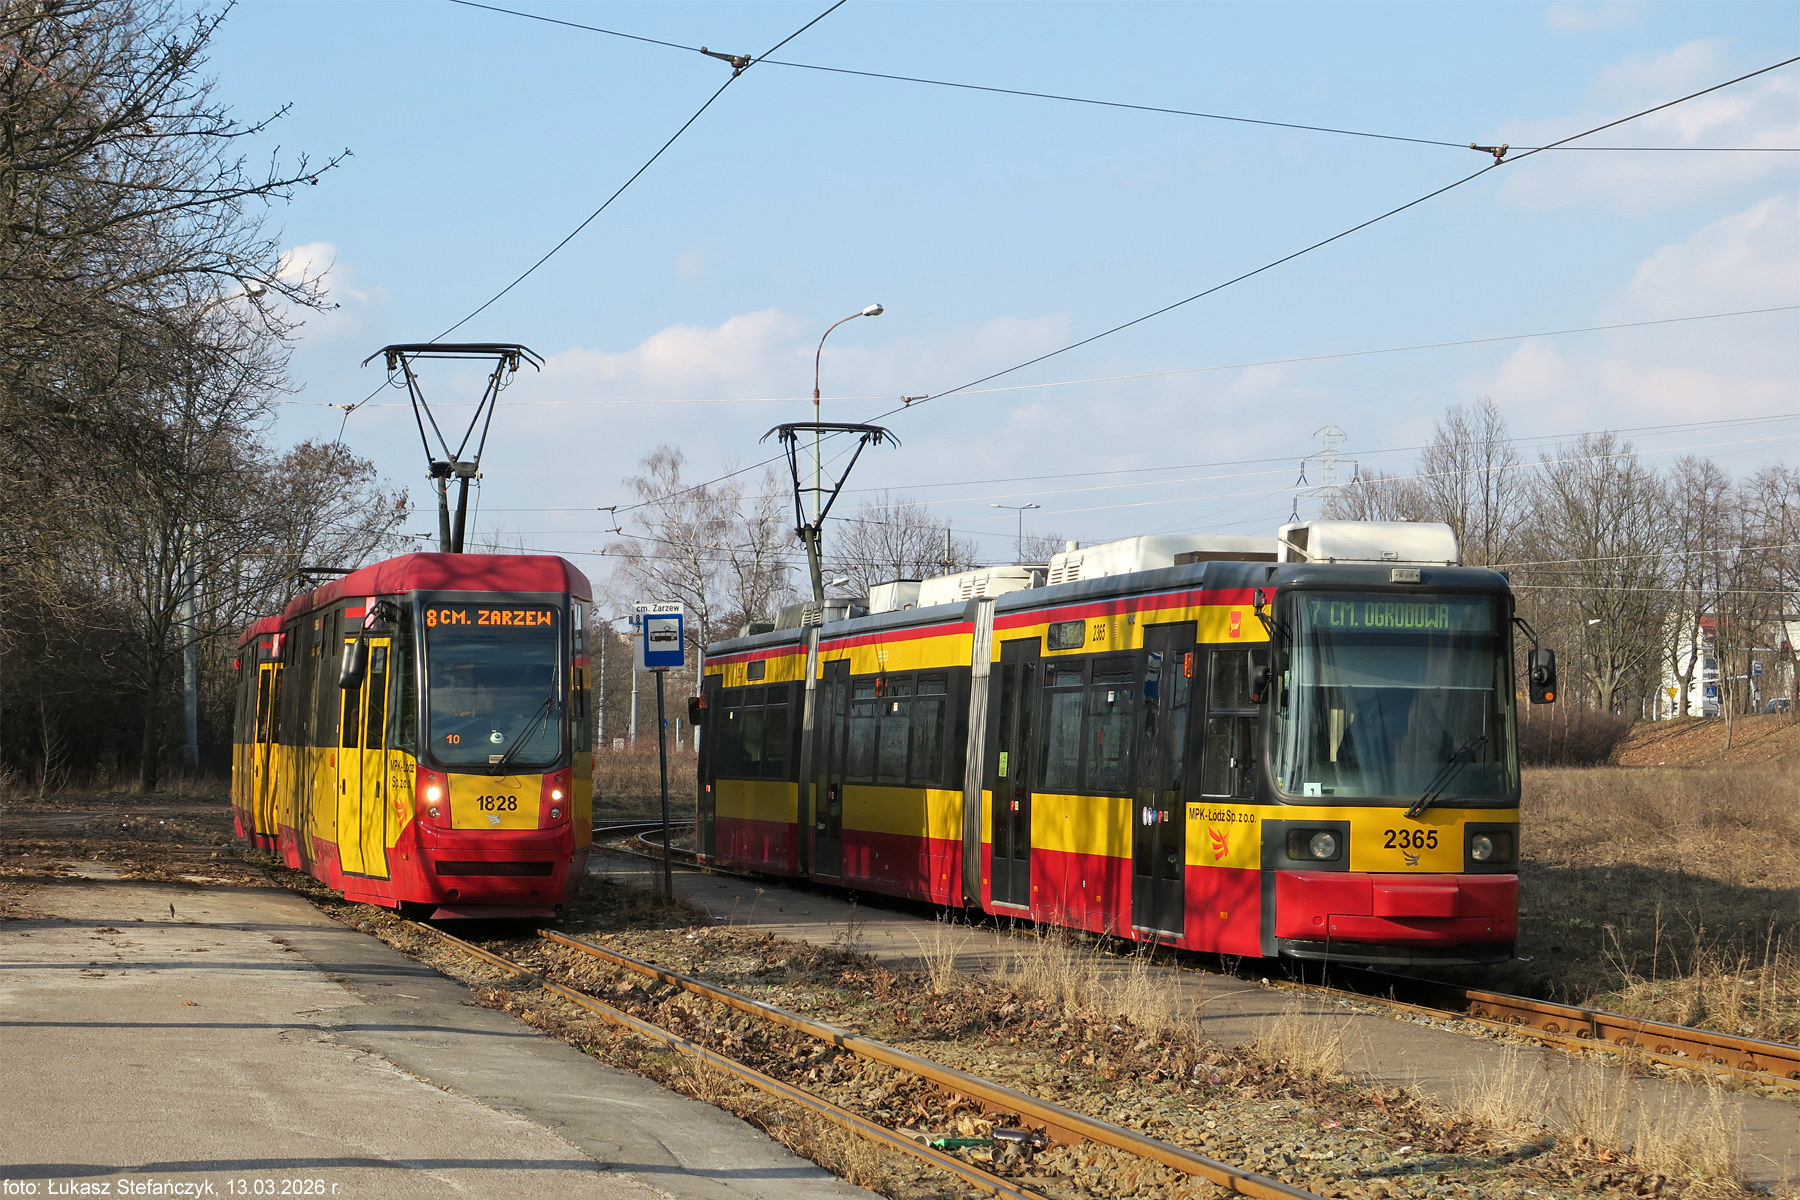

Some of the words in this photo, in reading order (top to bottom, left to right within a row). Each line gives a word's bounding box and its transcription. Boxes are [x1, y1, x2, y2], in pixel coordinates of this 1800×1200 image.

[652, 604, 680, 612] Zarzew
[1330, 601, 1358, 626] CM.
[1364, 602, 1449, 629] OGRODOWA
[426, 609, 437, 627] 8
[440, 609, 472, 625] CM.
[477, 609, 552, 626] ZARZEW
[635, 614, 641, 623] 8
[635, 625, 641, 634] 7
[1092, 623, 1106, 642] 2365
[446, 734, 460, 744] 10
[476, 795, 518, 812] 1828
[1189, 807, 1226, 822] MPK-Łódź
[1226, 809, 1238, 826] Sp.
[1238, 813, 1243, 823] z
[1243, 813, 1257, 824] o.o.
[1383, 829, 1439, 850] 2365
